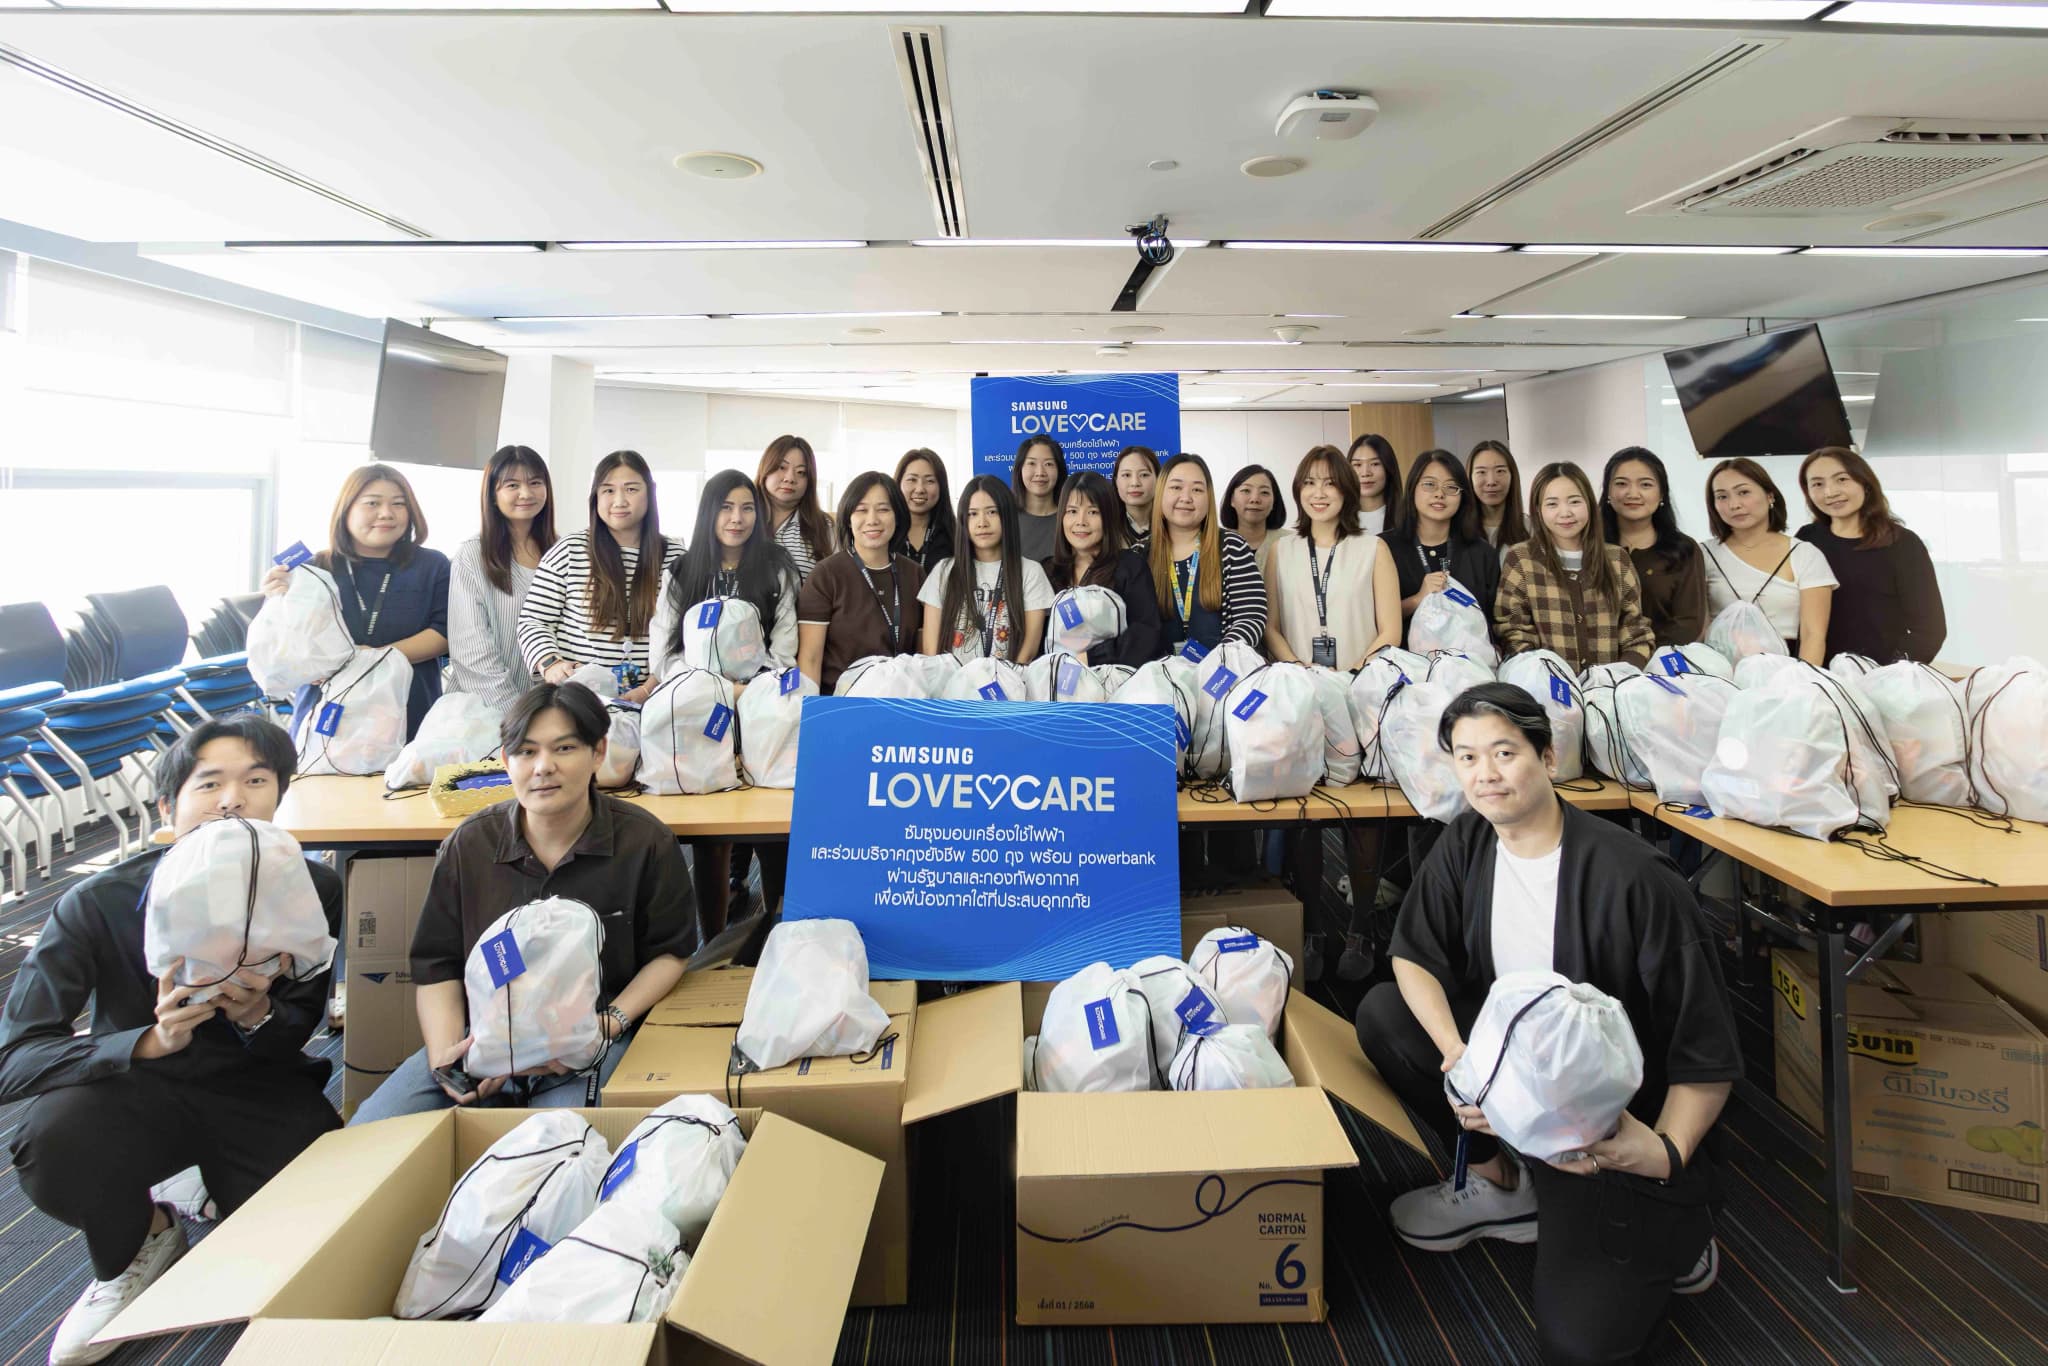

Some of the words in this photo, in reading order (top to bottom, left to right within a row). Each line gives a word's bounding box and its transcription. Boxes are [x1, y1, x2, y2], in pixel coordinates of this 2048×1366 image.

[1011, 400, 1068, 412] SAMSUNG
[1069, 451, 1084, 460] 500
[1101, 449, 1120, 458] พร้อ
[871, 745, 974, 765] SAMSUNG
[905, 824, 1065, 843] ซัมซุงมอบเครื่องใช้ไฟฟ้า
[811, 844, 966, 865] และร่วมบริจาคถุงยังชีพ
[971, 849, 999, 863] 500
[1005, 850, 1024, 867] ถุง
[1030, 848, 1072, 865] พร้อม
[1078, 851, 1156, 867] powerbank
[887, 867, 1079, 888] ผ่านรัฐบาลและกองทัพอากาศ
[874, 887, 1091, 912] เพื่อพี่น้องภาคใต้ที่ประสบอุทกภัย
[1862, 1034, 1914, 1055] บาท
[1258, 1212, 1307, 1223] NORMAL
[1259, 1225, 1306, 1235] CARTON
[1275, 1243, 1306, 1290] 6
